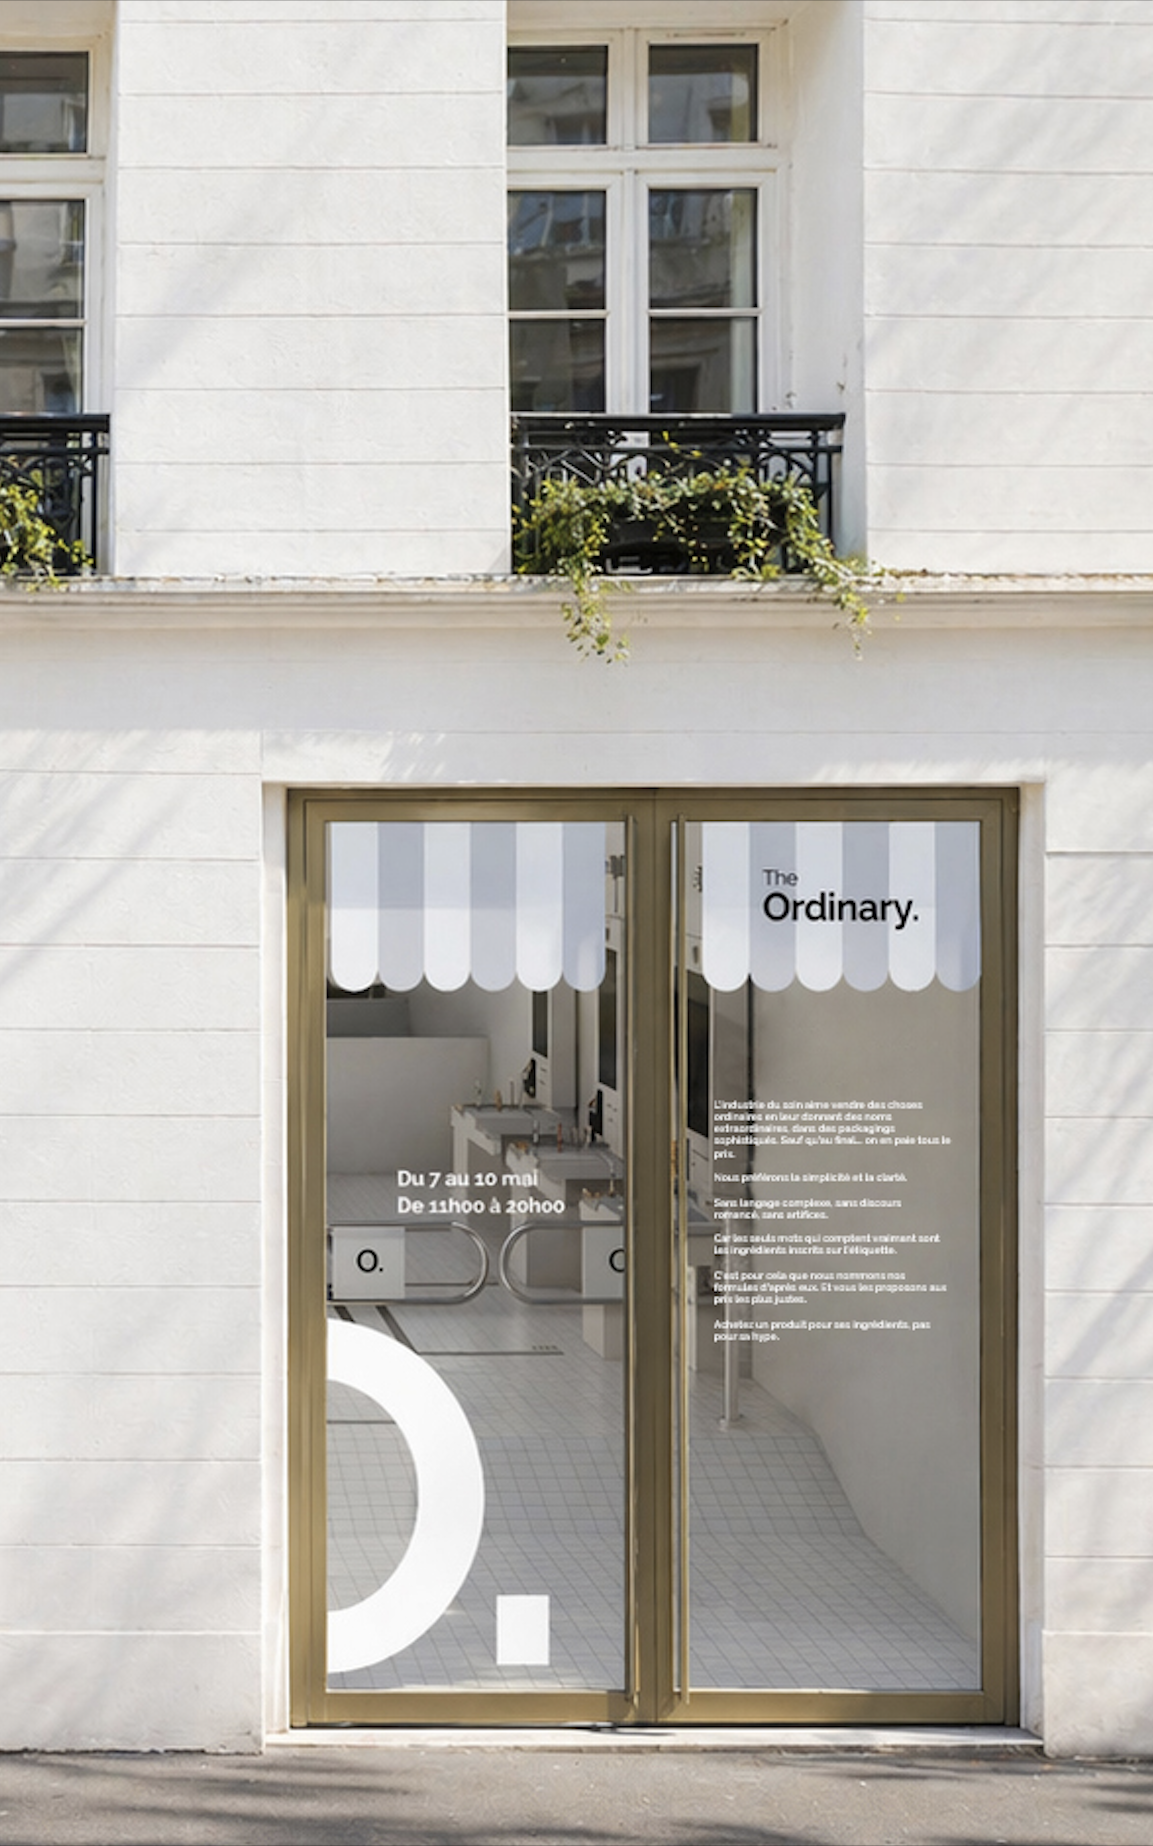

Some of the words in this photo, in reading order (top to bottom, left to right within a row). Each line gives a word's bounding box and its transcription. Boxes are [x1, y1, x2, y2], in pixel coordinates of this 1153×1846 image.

[762, 868, 799, 887] The
[763, 891, 919, 930] Ordinary.
[767, 1100, 781, 1109] du
[831, 1100, 865, 1109] vendre
[867, 1100, 886, 1109] des
[887, 1100, 923, 1109] choses
[714, 1112, 763, 1121] ordinaires
[779, 1112, 800, 1121] leur
[844, 1112, 863, 1121] des
[792, 1124, 817, 1133] dans
[818, 1124, 837, 1133] des
[838, 1124, 896, 1135] packagings
[781, 1136, 804, 1145] Sauf
[917, 1136, 940, 1145] tous
[941, 1136, 952, 1145] le
[397, 1170, 424, 1187] Du
[429, 1172, 441, 1188] 7
[445, 1173, 470, 1187] au
[475, 1173, 497, 1187] 10
[502, 1169, 538, 1187] mai
[714, 1172, 740, 1181] Nous
[790, 1172, 800, 1181] la
[852, 1172, 863, 1181] et
[865, 1172, 875, 1181] la
[397, 1197, 424, 1213] De
[429, 1197, 485, 1213] 11h00
[490, 1197, 501, 1213] à
[506, 1197, 566, 1213] 20h00
[714, 1198, 738, 1207] Sans
[739, 1198, 780, 1209] langage
[859, 1198, 902, 1207] discours
[714, 1233, 731, 1242] Car
[732, 1233, 749, 1242] les
[749, 1233, 776, 1242] seuls
[777, 1233, 803, 1242] mots
[804, 1233, 821, 1244] qui
[822, 1233, 871, 1244] comptent
[918, 1233, 941, 1242] sont
[714, 1245, 729, 1254] les
[356, 1248, 384, 1273] O.
[741, 1273, 764, 1282] pour
[765, 1271, 787, 1280] cela
[789, 1273, 809, 1282] que
[821, 1283, 832, 1292] Et
[858, 1283, 874, 1292] les
[734, 1295, 750, 1304] les
[751, 1295, 773, 1306] plus
[714, 1320, 754, 1329] Achetez
[770, 1320, 807, 1331] produit
[808, 1322, 833, 1331] pour
[912, 1322, 931, 1331] pas
[714, 1334, 738, 1343] pour
[751, 1332, 781, 1343] hype.
